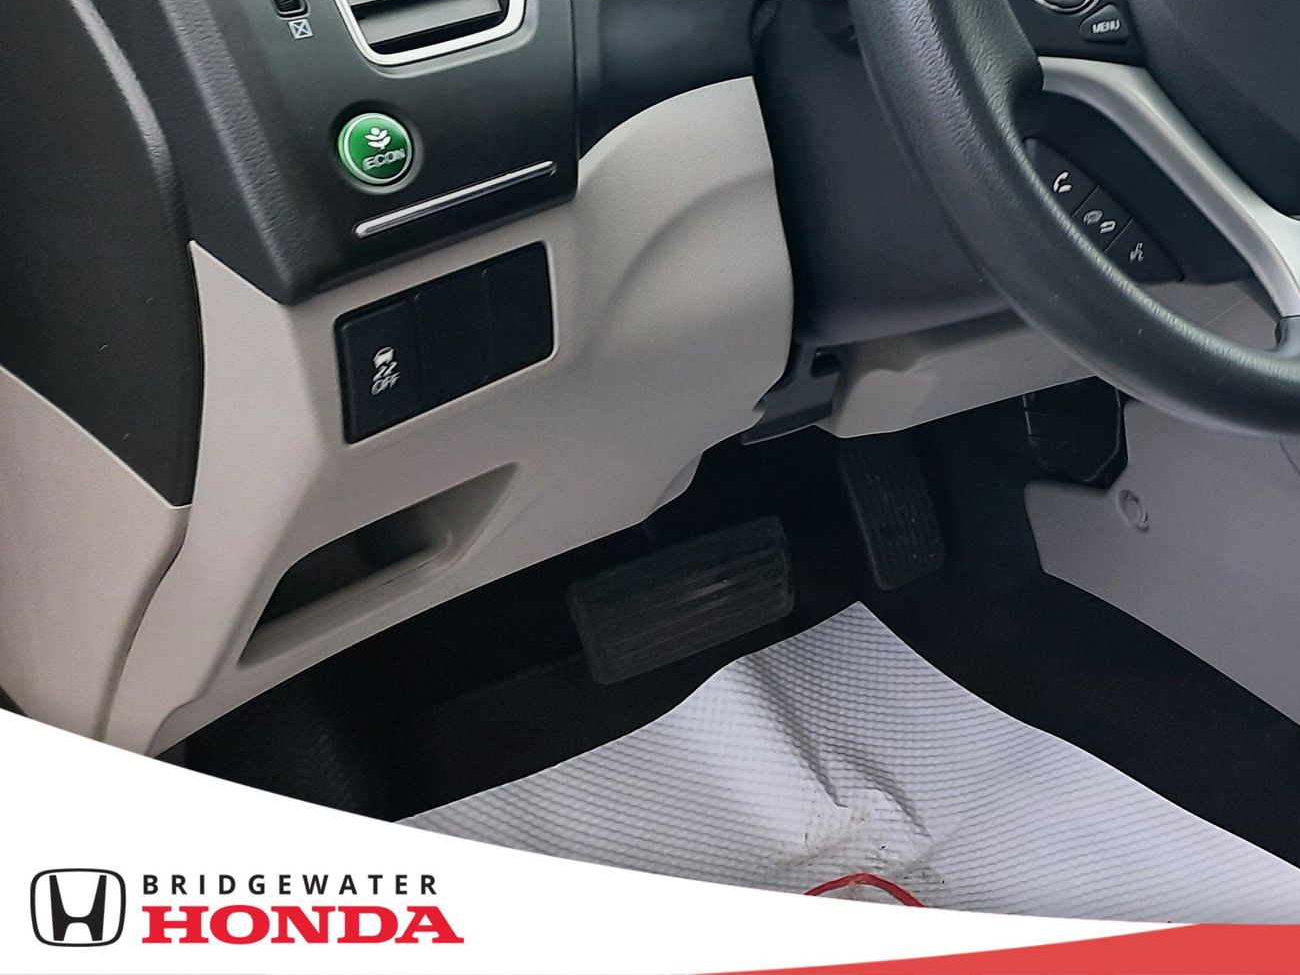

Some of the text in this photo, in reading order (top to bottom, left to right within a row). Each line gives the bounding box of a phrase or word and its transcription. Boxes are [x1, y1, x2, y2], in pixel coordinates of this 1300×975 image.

[1092, 20, 1121, 34] MENU
[362, 148, 406, 171] ECON
[371, 372, 400, 395] OFF
